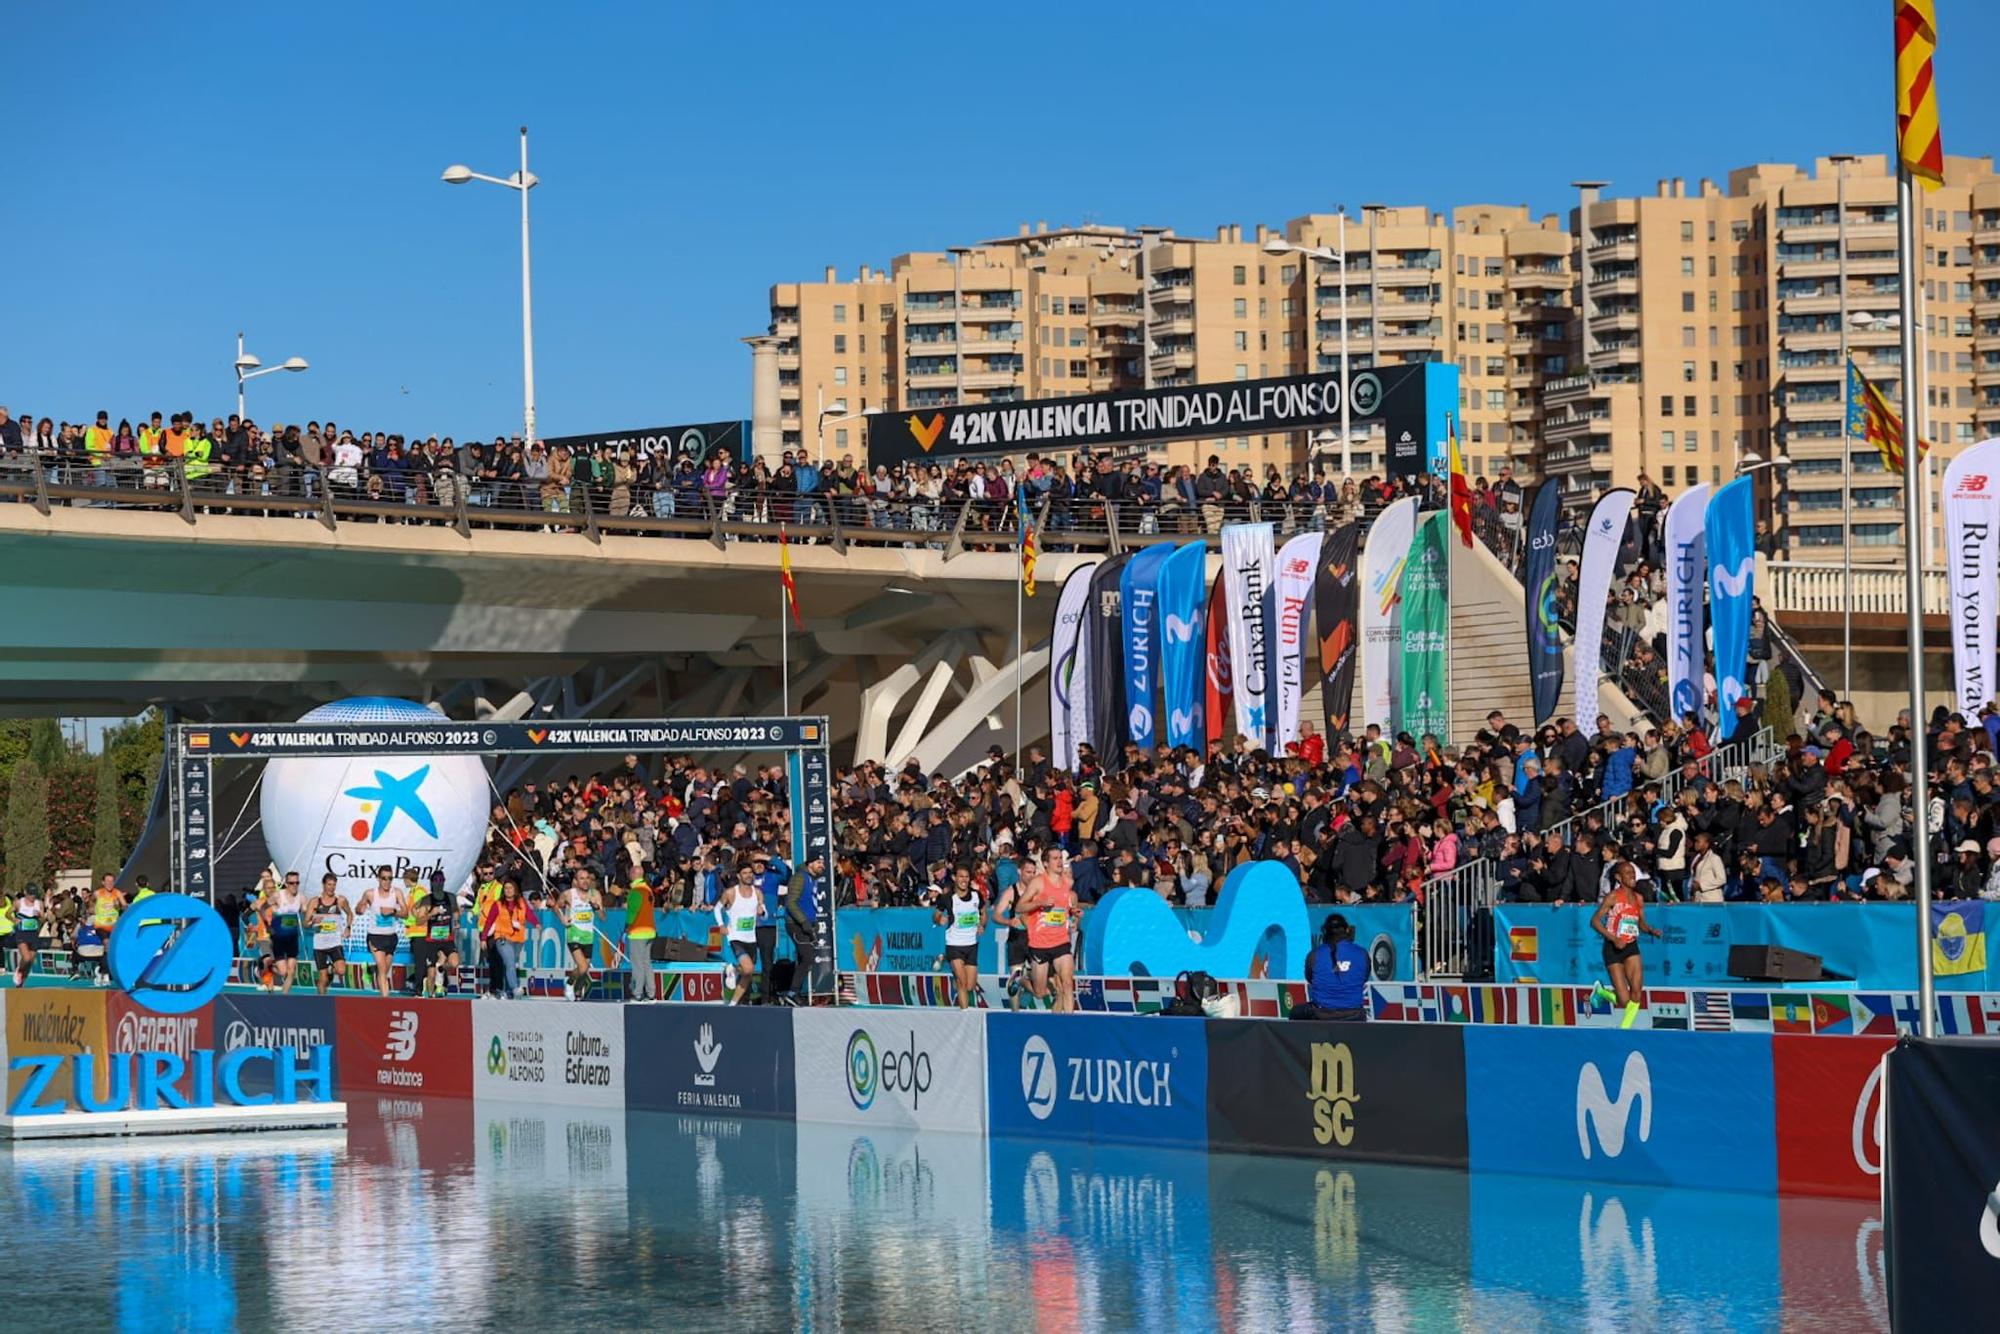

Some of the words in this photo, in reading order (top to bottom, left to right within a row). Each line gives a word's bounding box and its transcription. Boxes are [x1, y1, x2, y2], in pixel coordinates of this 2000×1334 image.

[949, 411, 998, 445] 42K
[999, 402, 1111, 442] VALENCIA
[1114, 391, 1224, 432] TRINIDAD
[1225, 380, 1340, 422] ALFONSO
[1963, 522, 1988, 579] Run
[1281, 596, 1305, 645] Run
[1676, 542, 1695, 662] ZURICH
[1957, 591, 1980, 655] your
[1132, 589, 1154, 692] ZURICH
[1239, 558, 1267, 696] CaixaBank
[250, 732, 276, 746] 42K
[277, 731, 335, 746] VALENCIA
[336, 732, 389, 746] TRINIDAD
[389, 731, 444, 745] ALFONSO
[445, 731, 479, 745] 2023
[547, 730, 572, 743] 42K
[573, 729, 628, 743] VALENCIA
[629, 728, 679, 742] TRINIDAD
[681, 728, 732, 741] ALFONSO
[733, 727, 766, 741] 2023
[887, 932, 923, 950] VALENCIA
[23, 1005, 87, 1053] meléndez
[566, 1031, 601, 1057] Cultura
[601, 1044, 610, 1057] del
[392, 1067, 423, 1088] balance
[508, 1046, 544, 1064] TRINIDAD
[509, 1065, 545, 1083] ALFONSO
[565, 1057, 611, 1086] Esfuerzo
[881, 1030, 933, 1111] edp
[6, 1045, 334, 1116] ZURICH
[678, 1091, 701, 1106] FERIA
[702, 1092, 742, 1108] VALENCIA
[1067, 1056, 1172, 1107] ZURICH
